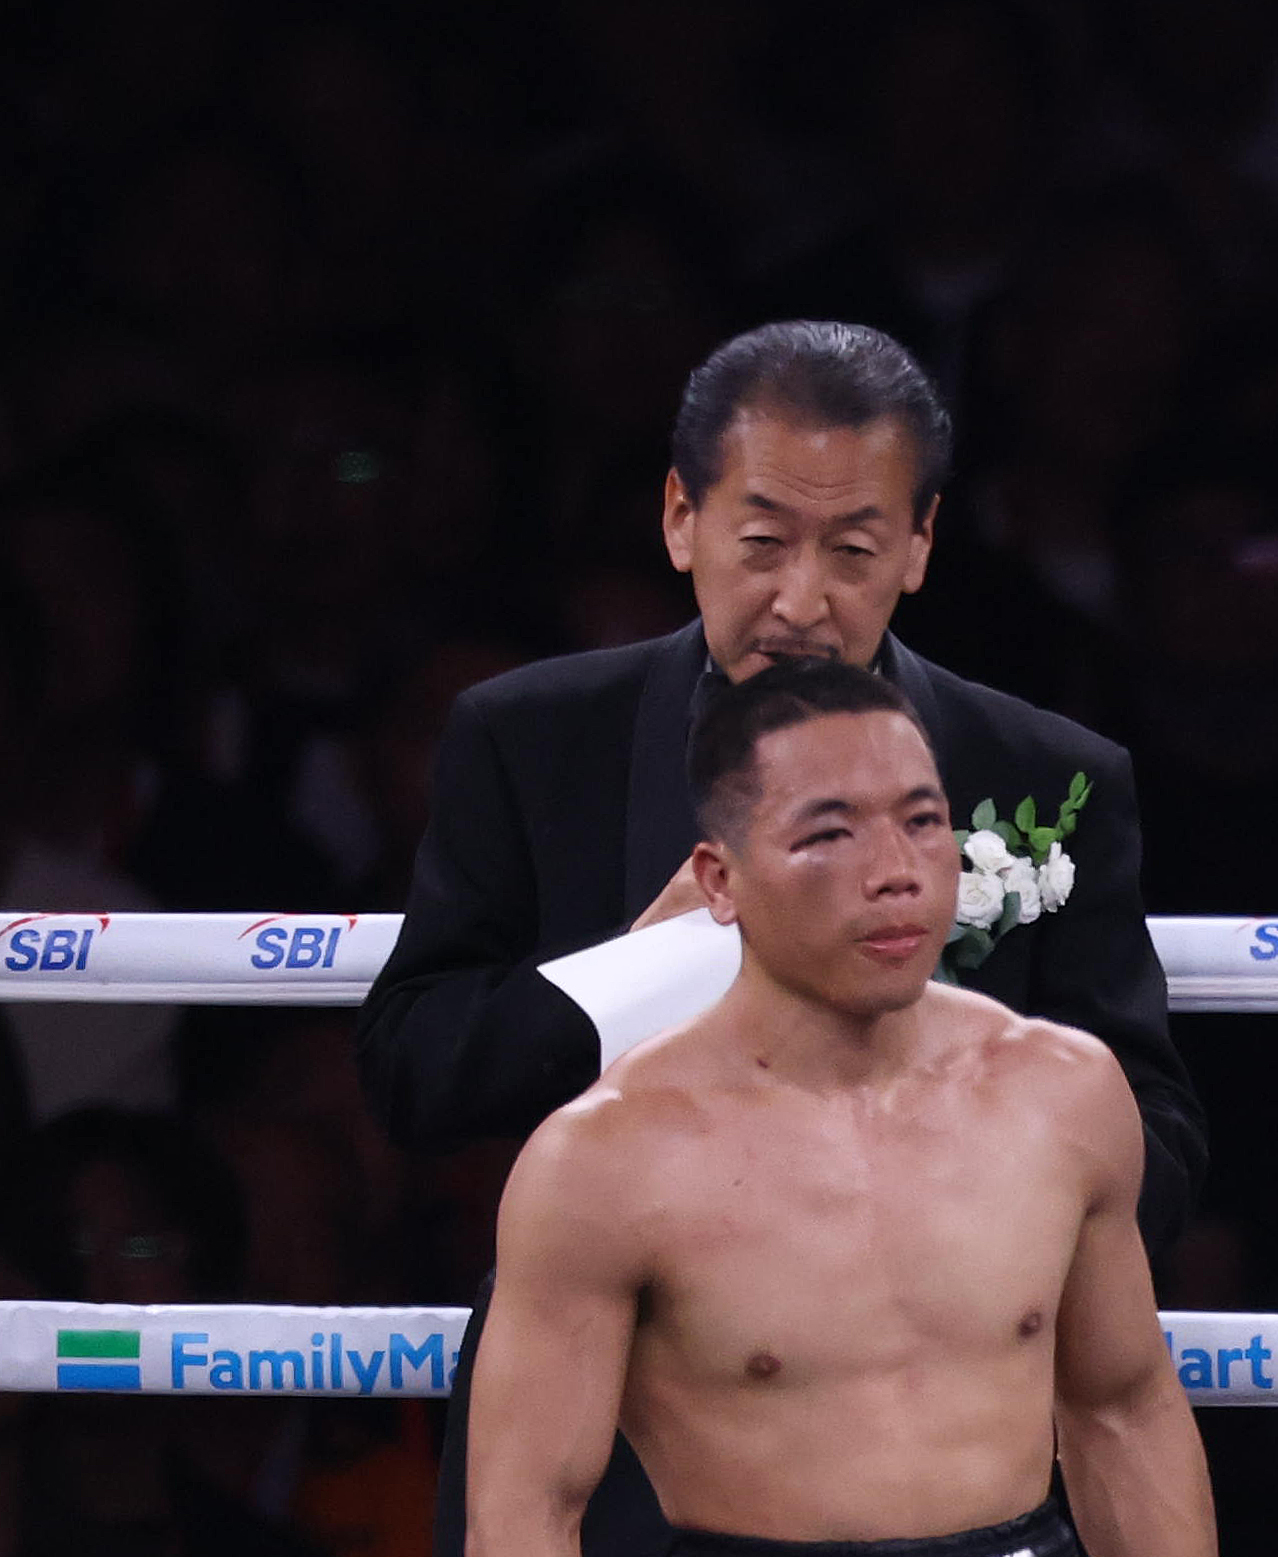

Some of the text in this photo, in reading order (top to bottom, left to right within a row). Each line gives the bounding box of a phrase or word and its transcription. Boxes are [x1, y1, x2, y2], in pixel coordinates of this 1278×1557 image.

[5, 928, 95, 972] SBI
[250, 926, 342, 970] SBI
[170, 1331, 461, 1396] FamilyM
[1165, 1331, 1274, 1391] art
